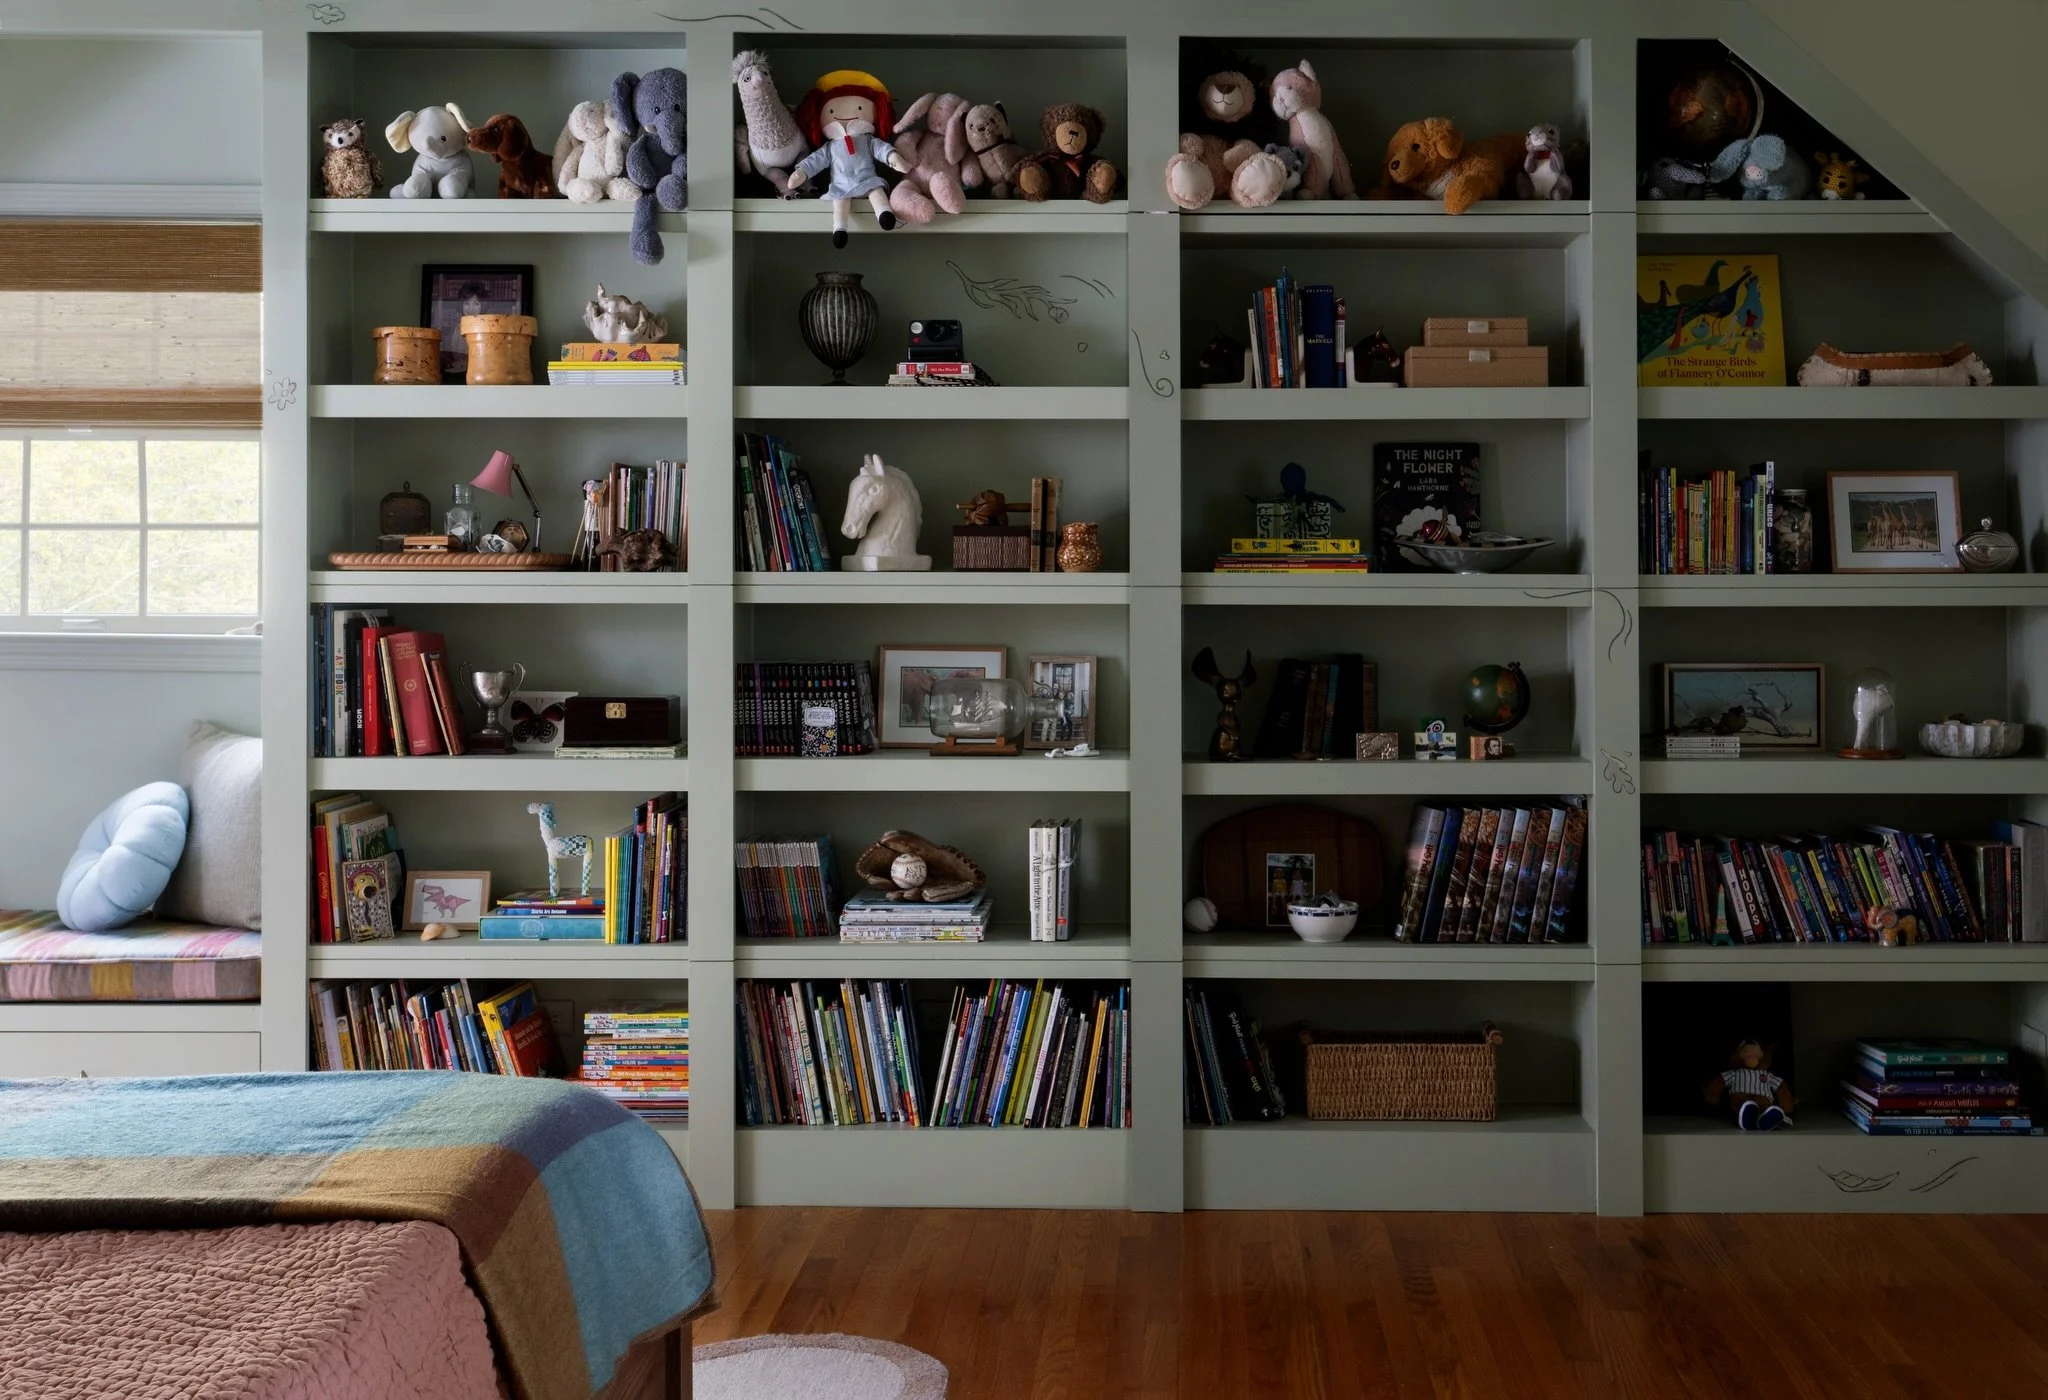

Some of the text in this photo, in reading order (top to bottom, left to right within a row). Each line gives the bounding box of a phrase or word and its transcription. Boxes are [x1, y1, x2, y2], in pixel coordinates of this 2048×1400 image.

[1665, 356, 1756, 369] The Strange Birds
[1658, 369, 1766, 380] of Flannery O'Connor
[1394, 449, 1462, 461] THE NIGHT
[1403, 462, 1453, 474] FLOWER
[336, 656, 344, 671] ART
[335, 674, 344, 696] BOOK
[1032, 862, 1041, 876] Light
[1900, 872, 1915, 897] UNICO
[1033, 896, 1041, 910] Attic
[1738, 868, 1760, 925] HOOPS
